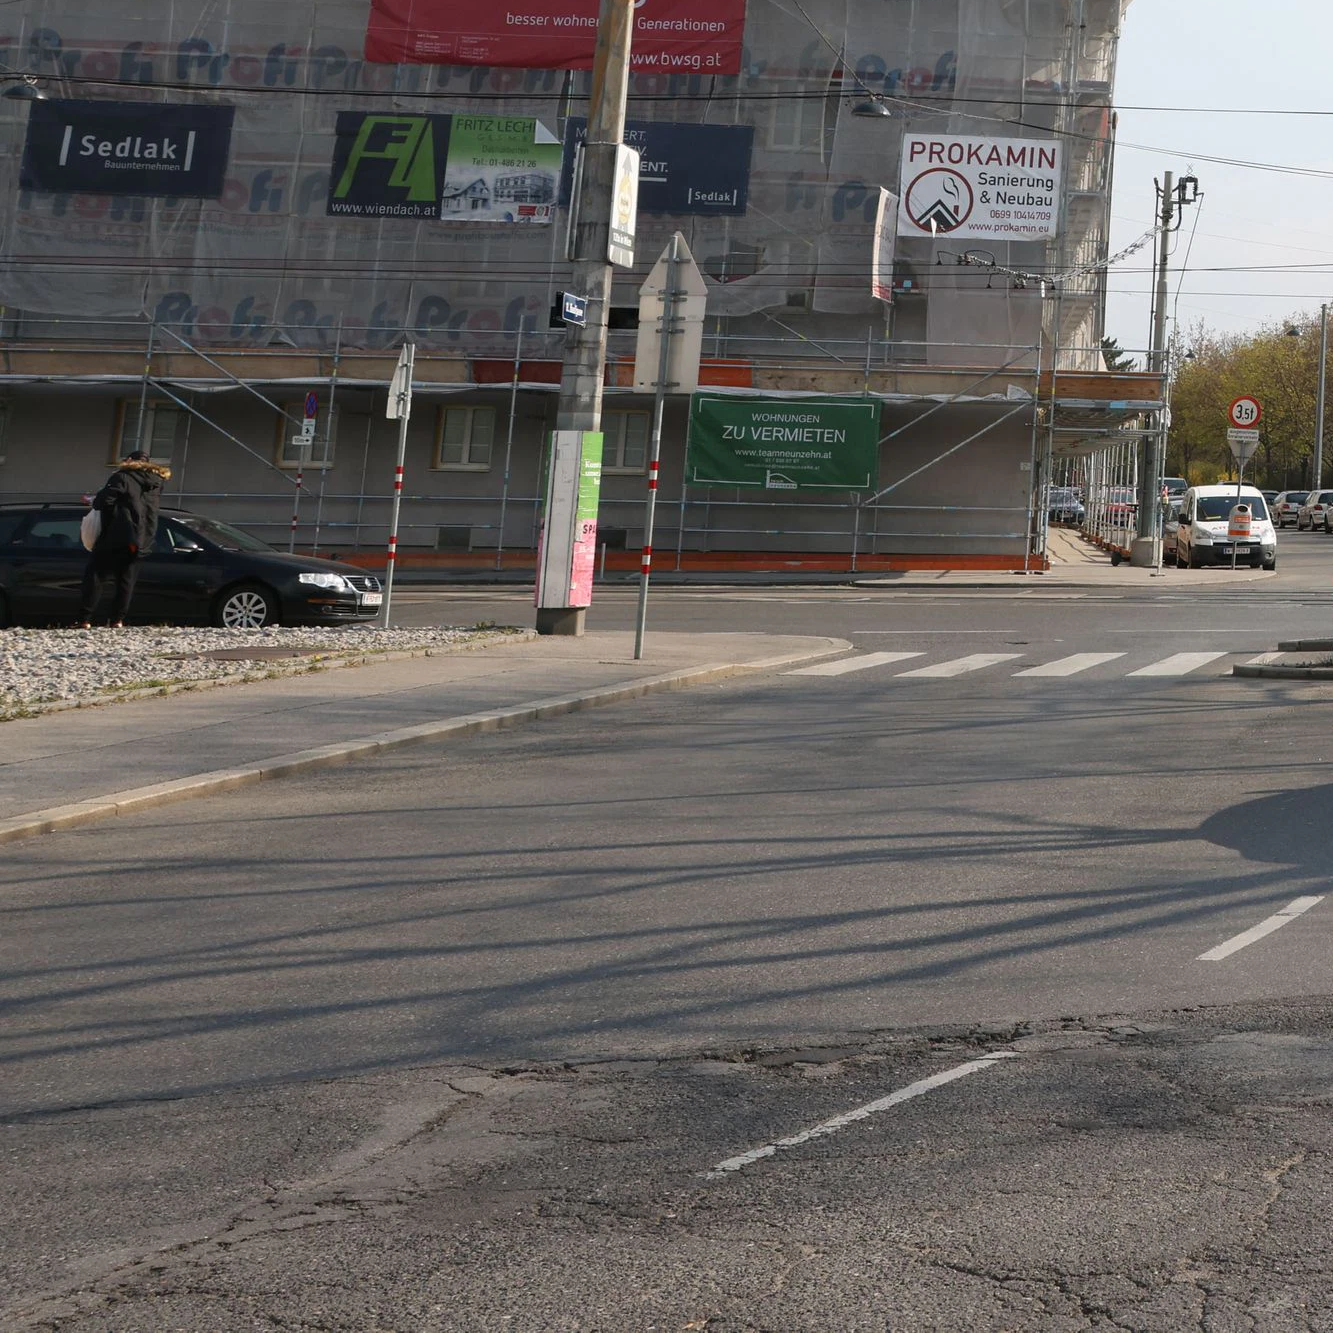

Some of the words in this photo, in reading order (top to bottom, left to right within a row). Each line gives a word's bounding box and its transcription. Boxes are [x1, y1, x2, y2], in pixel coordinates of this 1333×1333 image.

[506, 12, 549, 26] besser
[637, 16, 725, 32] Generationen
[630, 52, 721, 68] ww.bwsg.at
[456, 119, 494, 131] FRITZ
[79, 135, 178, 159] Sedlak
[909, 141, 1056, 169] PROKAMIN
[104, 160, 180, 171] Bauunternehmen
[527, 160, 537, 168] 26
[978, 172, 1054, 191] Sanierung
[694, 191, 731, 201] Sedlak
[979, 191, 991, 204] &
[996, 192, 1053, 206] Neubau
[331, 203, 436, 216] www.wiendach.at
[990, 210, 1011, 219] 0699
[1013, 211, 1051, 220] 10414709
[968, 222, 1049, 233] www.prokamin.eu
[752, 413, 820, 423] WOHNUNGEN
[1235, 404, 1254, 421] 3,5t
[722, 425, 745, 440] ZU
[751, 427, 846, 442] VERMIETEN
[735, 448, 832, 459] www.teamneunzehn.at
